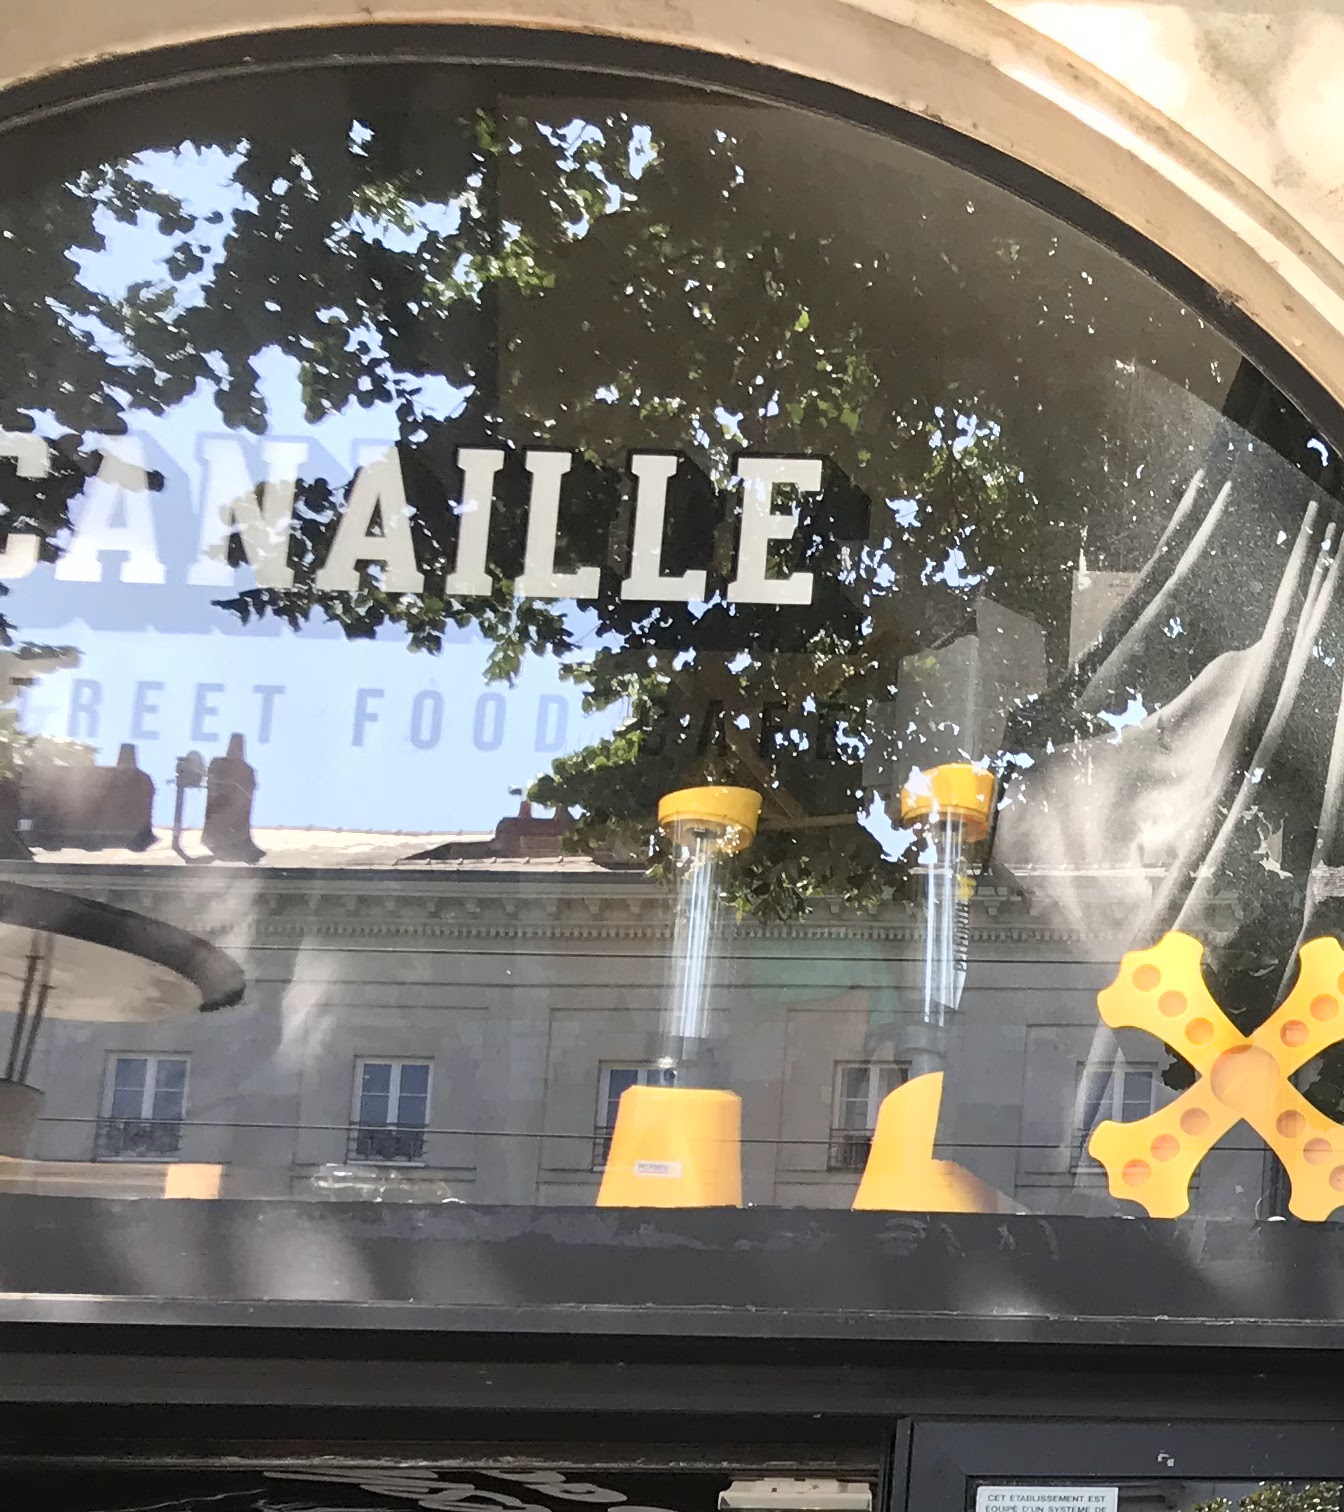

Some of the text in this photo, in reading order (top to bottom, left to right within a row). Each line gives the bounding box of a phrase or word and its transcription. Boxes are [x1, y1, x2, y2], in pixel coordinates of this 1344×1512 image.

[350, 688, 569, 753] FOOD
[987, 1494, 1007, 1503] CET
[1088, 1495, 1106, 1503] EST
